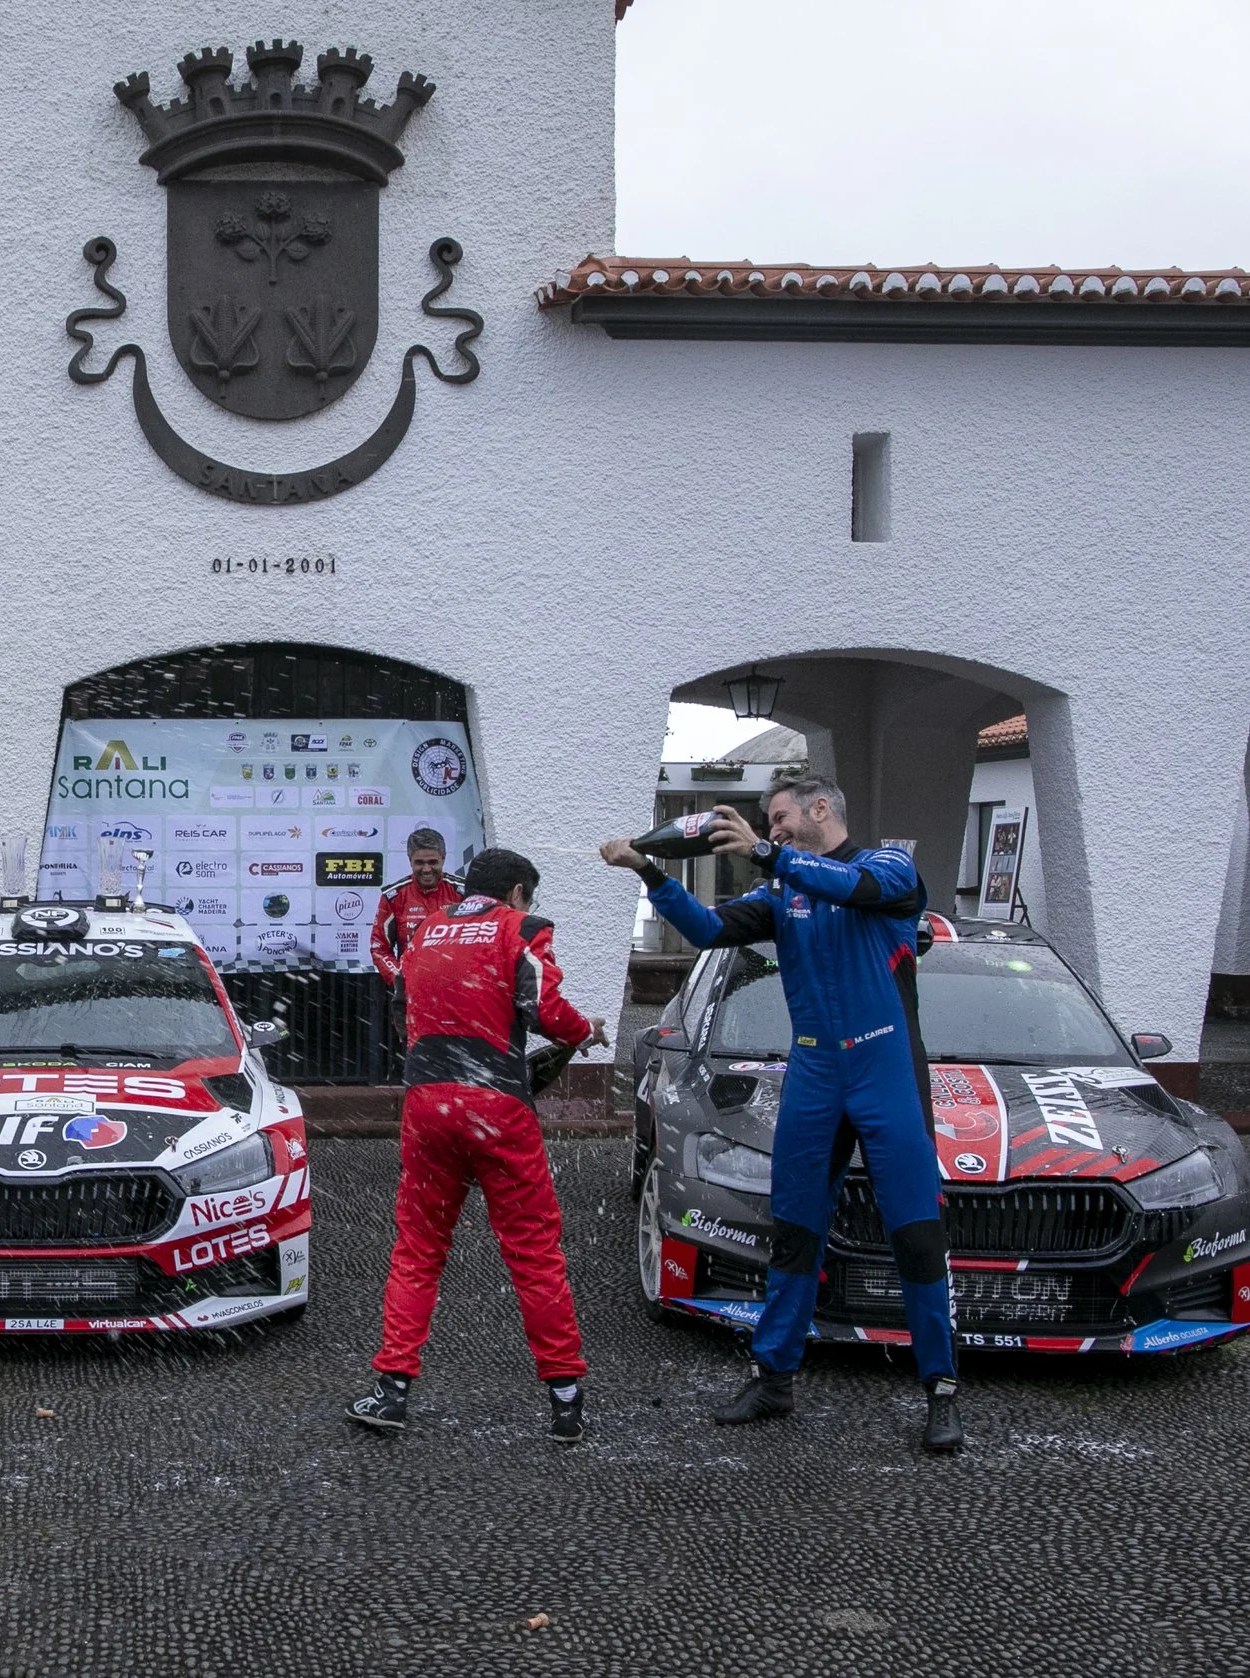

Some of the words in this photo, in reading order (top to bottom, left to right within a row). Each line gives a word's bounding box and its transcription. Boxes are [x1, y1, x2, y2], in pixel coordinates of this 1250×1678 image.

[200, 465, 353, 501] SANTANA
[212, 557, 337, 574] 01-01-2001
[412, 743, 429, 768] DESIGN
[440, 739, 467, 775] MARKETING
[58, 775, 189, 799] Santana
[415, 776, 460, 795] PUBLICIDADE
[357, 796, 384, 806] CORAL
[175, 830, 200, 838] REIS
[202, 830, 227, 838] CAR
[195, 861, 228, 870] electro
[262, 864, 302, 872] CASSIANOS
[325, 859, 375, 872] FBI
[195, 870, 216, 878] som
[327, 872, 373, 880] Automóveis
[338, 898, 361, 913] pizza
[457, 903, 483, 911] OMP
[261, 930, 294, 940] PETER'S
[423, 921, 499, 940] LOTES
[459, 936, 495, 944] TEAM
[864, 1025, 895, 1040] CAIRES
[1021, 1073, 1104, 1150] ZEISS
[687, 1208, 757, 1246] Bioforma
[173, 1223, 271, 1272] LOTES
[1190, 1229, 1246, 1258] Bioforma
[211, 1300, 264, 1320] MVASCONCELOS
[11, 1319, 32, 1328] 2SA
[36, 1319, 57, 1328] L4E
[88, 1319, 147, 1329] virtualcar
[962, 1334, 985, 1345] TS
[994, 1336, 1022, 1347] 551
[1143, 1332, 1179, 1349] Alberto
[1180, 1327, 1209, 1340] OCULISTA
